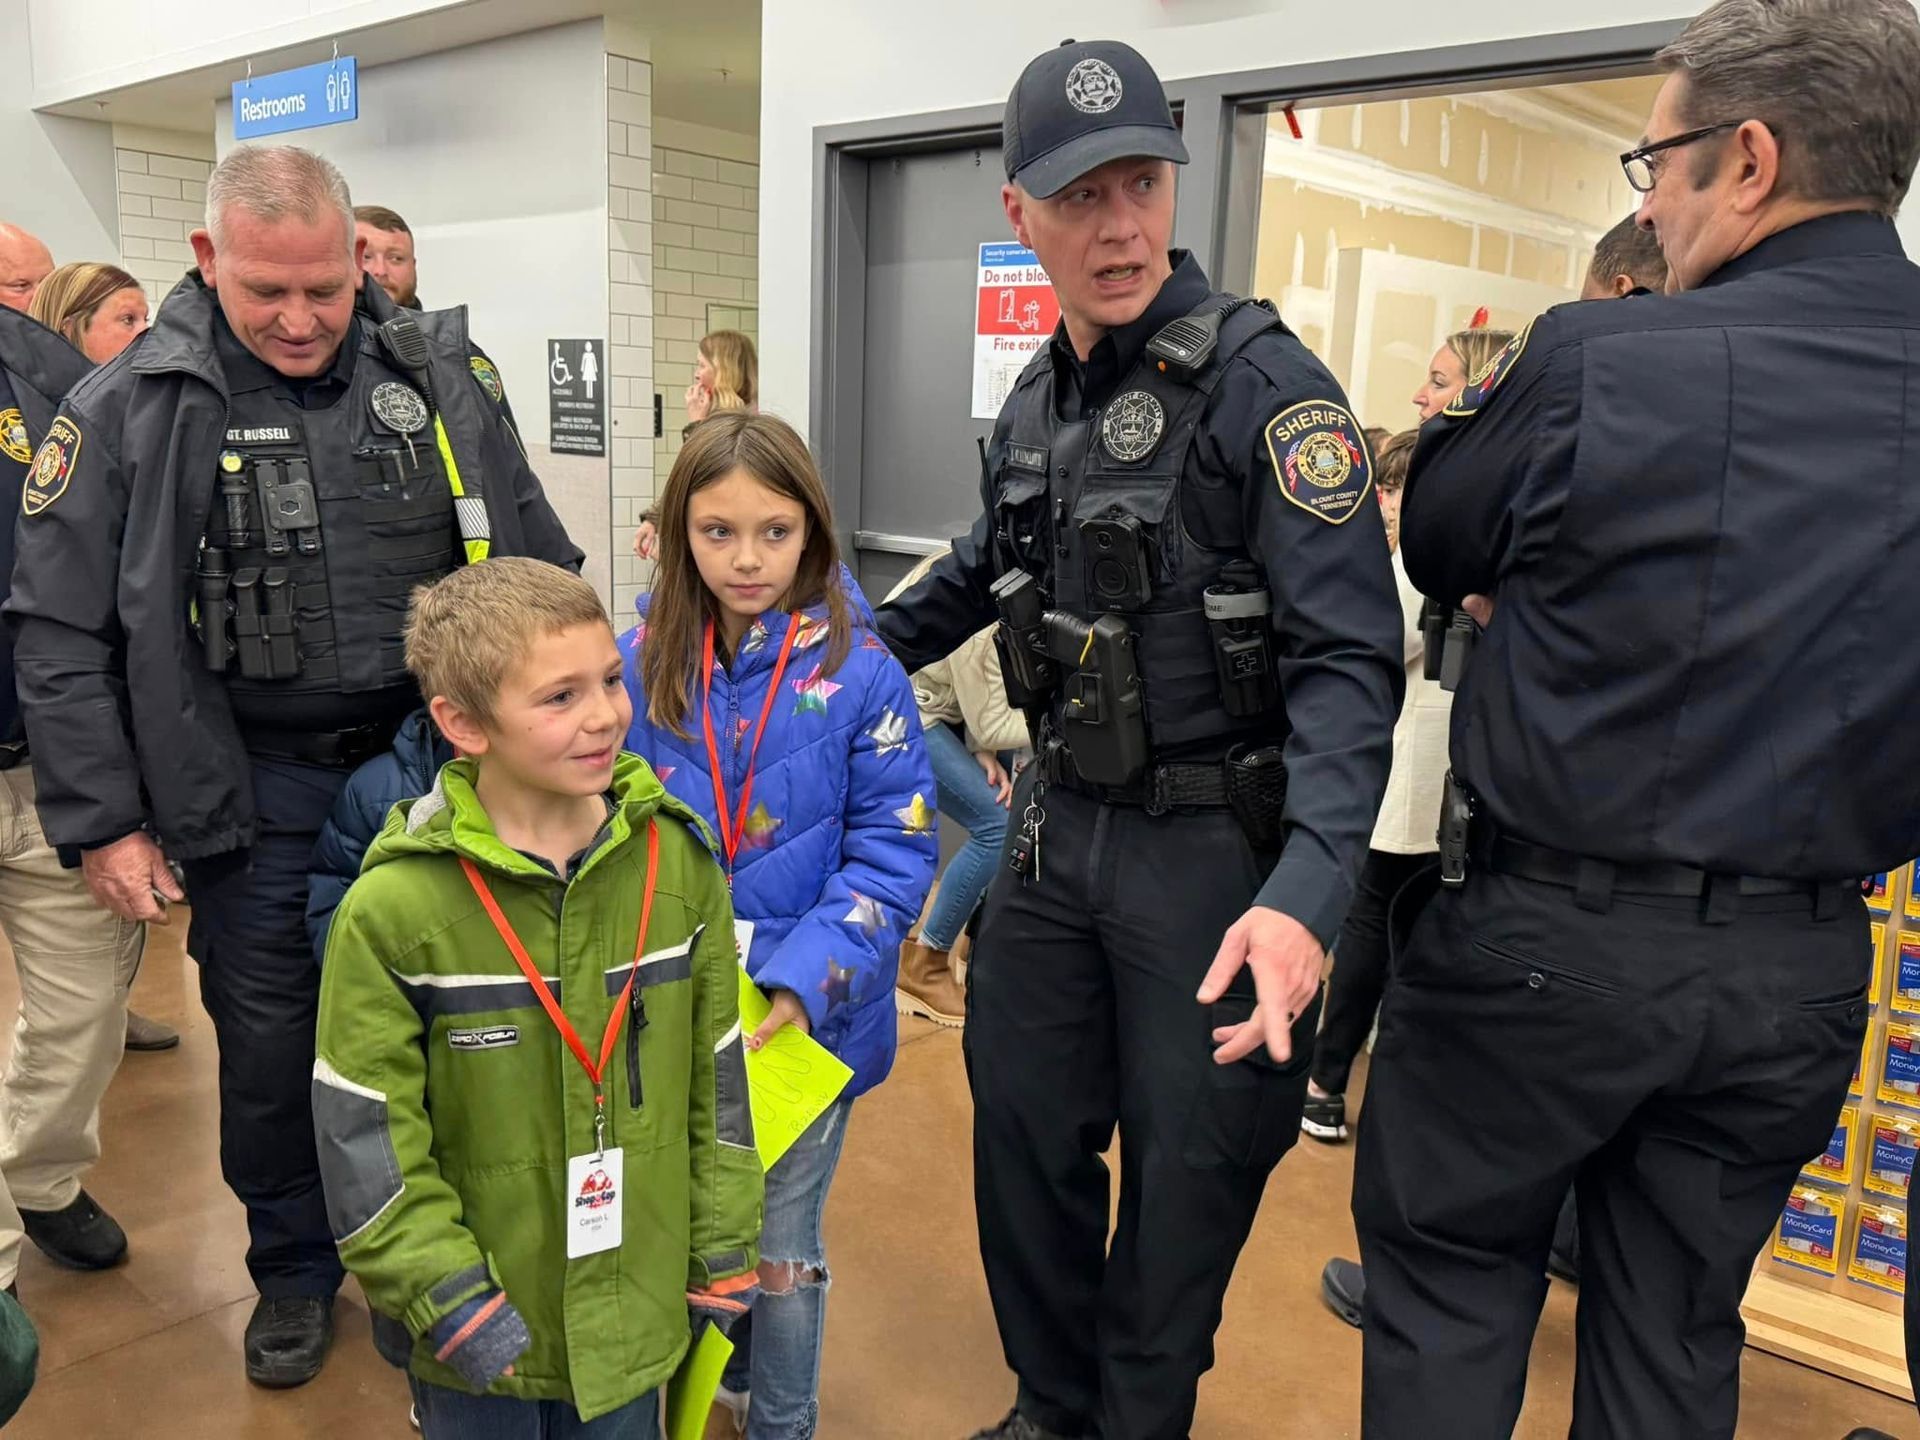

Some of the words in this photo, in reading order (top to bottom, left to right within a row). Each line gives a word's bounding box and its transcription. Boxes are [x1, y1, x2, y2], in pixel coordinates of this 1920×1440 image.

[240, 93, 306, 122] Restrooms
[984, 270, 1000, 283] Do
[1003, 269, 1022, 283] not
[993, 338, 1015, 351] Fire
[1018, 337, 1040, 351] exit
[1275, 410, 1347, 442] SHERIFF
[243, 427, 291, 441] RUSSELL
[1310, 494, 1336, 505] BLOUNT
[1336, 491, 1358, 502] COUNTY
[1889, 1059, 1920, 1073] Money
[1785, 1217, 1833, 1236] MoneyCard
[1861, 1238, 1906, 1258] MoneyCar
